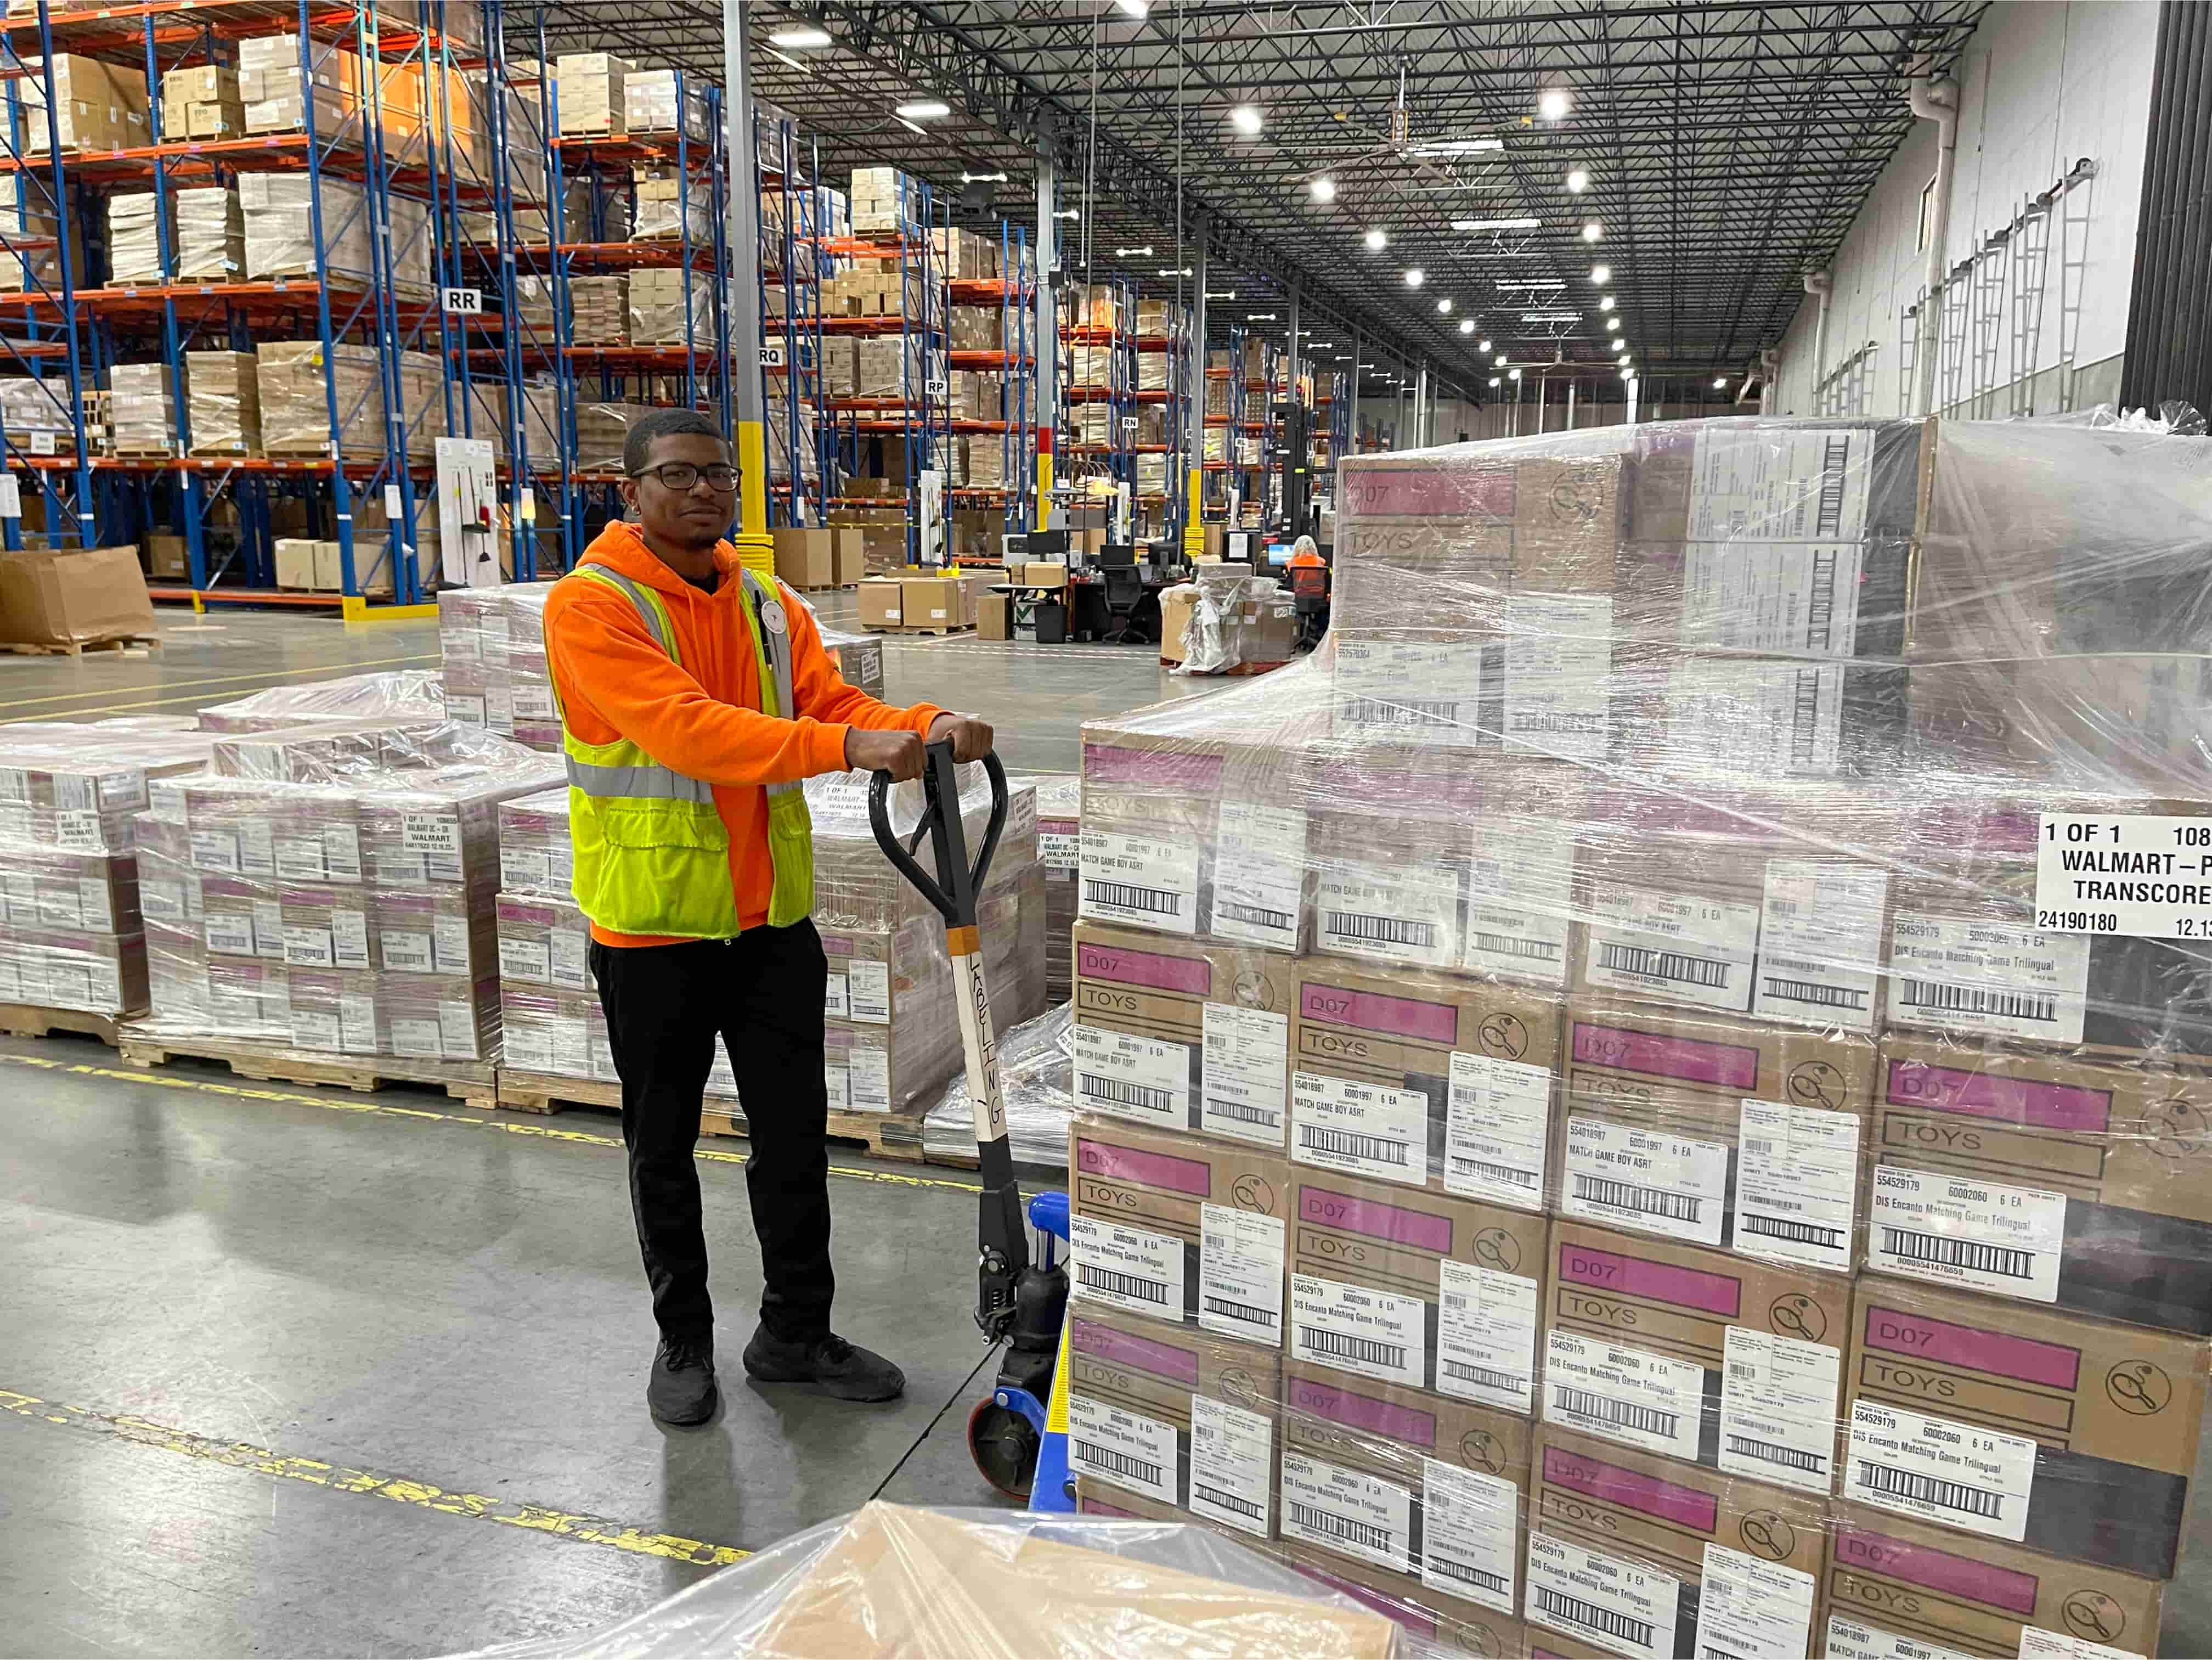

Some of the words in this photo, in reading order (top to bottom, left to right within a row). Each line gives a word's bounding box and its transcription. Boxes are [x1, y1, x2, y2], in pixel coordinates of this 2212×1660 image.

[450, 292, 475, 308] RR
[759, 350, 778, 363] RQ
[929, 382, 944, 392] RP
[1350, 532, 1413, 549] TOYS
[411, 834, 450, 842] WALMART
[2045, 823, 2055, 841] 1
[2067, 824, 2098, 842] OF
[2109, 825, 2119, 843] 1
[2173, 827, 2211, 846] 108
[1081, 853, 1099, 864] MATCH
[1101, 856, 1116, 867] GAME
[1116, 859, 1128, 869] BOY
[1701, 908, 1707, 918] 6
[1711, 910, 1721, 920] EA
[2039, 910, 2117, 932] 24190180
[2022, 935, 2028, 946] 6
[2034, 936, 2045, 947] EA
[1086, 955, 1119, 973] D07
[2013, 957, 2055, 974] Trilingual
[1086, 990, 1137, 1010] TOYS
[1311, 997, 1350, 1014] D07
[970, 955, 1001, 1124] LABELING
[1308, 1034, 1368, 1057] TOYS
[1585, 1037, 1630, 1058] D07
[1076, 1048, 1093, 1060] MATCH
[1122, 1057, 1135, 1068] ASRT
[1156, 1048, 1163, 1057] EA
[1295, 1079, 1325, 1093] 554018987
[1345, 1088, 1372, 1101] 60001997
[1381, 1094, 1385, 1103] 6
[1389, 1095, 1397, 1105] EA
[1581, 1078, 1651, 1102] TOYS
[1903, 1079, 1960, 1098] D07
[1294, 1097, 1314, 1109] MATCH
[1316, 1101, 1334, 1113] GAME
[1335, 1104, 1347, 1115] BOY
[1348, 1107, 1364, 1118] ASRT
[1571, 1125, 1607, 1141] 554018987
[1629, 1136, 1662, 1151] 60001997
[1672, 1145, 1678, 1155] 6
[1681, 1146, 1691, 1157] EA
[1898, 1123, 1982, 1150] TOYS
[1086, 1151, 1118, 1172] D07
[1569, 1144, 1593, 1158] MATCH
[1595, 1150, 1616, 1163] GAME
[1617, 1153, 1632, 1166] BOY
[1633, 1157, 1652, 1170] ASRT
[1086, 1185, 1137, 1206] TOYS
[1877, 1174, 1920, 1191] 554529179
[1948, 1186, 1988, 1202] 60002060
[2000, 1194, 2006, 1205] 6
[2011, 1196, 2022, 1208] EA
[1309, 1200, 1346, 1219] D07
[1875, 1195, 1889, 1208] DIS
[1892, 1198, 1923, 1213] Encanto
[1925, 1203, 1962, 1222] Matching
[1965, 1210, 1989, 1225] Game
[1991, 1215, 2030, 1234] Trilingual
[1101, 1246, 1123, 1261] Matching
[1125, 1252, 1139, 1263] Game
[1145, 1240, 1148, 1248] 6
[1151, 1241, 1157, 1250] EA
[1308, 1237, 1365, 1261] TOYS
[1572, 1259, 1616, 1280] D07
[1897, 1257, 1963, 1276] 00005541476659
[1294, 1282, 1323, 1296] 554529179
[1343, 1292, 1370, 1306] 60002060
[1379, 1300, 1383, 1309] 6
[1387, 1302, 1394, 1311] EA
[1294, 1299, 1303, 1310] DIS
[1305, 1302, 1327, 1315] Encanto
[1329, 1307, 1354, 1322] Matching
[1356, 1313, 1372, 1325] Game
[1374, 1316, 1401, 1332] Trilingual
[1569, 1297, 1637, 1324] TOYS
[1880, 1323, 1934, 1346] D07
[1550, 1338, 1585, 1355] 554529179
[1607, 1352, 1640, 1369] 60002060
[1650, 1362, 1655, 1372] 6
[1659, 1364, 1668, 1375] EA
[1082, 1365, 1129, 1389] TOYS
[1549, 1357, 1560, 1368] DIS
[1562, 1360, 1588, 1375] Encanto
[1589, 1366, 1620, 1385] Matching
[1622, 1375, 1641, 1388] Game
[1643, 1380, 1675, 1399] Trilingual
[1875, 1365, 1955, 1396] TOYS
[1299, 1391, 1335, 1410] D07
[1098, 1425, 1119, 1440] Matching
[1299, 1427, 1353, 1451] TOYS
[1854, 1410, 1896, 1429] 554529179
[1923, 1426, 1961, 1444] 60002060
[1972, 1438, 1978, 1448] 6
[1983, 1440, 1994, 1451] EA
[1853, 1430, 1866, 1442] DIS
[1869, 1434, 1899, 1450] Encanto
[1900, 1442, 1936, 1461] Matching
[1938, 1450, 1961, 1465] Game
[1963, 1456, 2001, 1477] Trilingual
[1331, 1473, 1358, 1489] 60002060
[1374, 1486, 1381, 1496] EA
[1295, 1479, 1316, 1493] Encanto
[1317, 1486, 1342, 1503] Matching
[1344, 1494, 1359, 1507] Game
[1361, 1499, 1387, 1517] Trilingual
[1872, 1489, 1936, 1512] 00005541476659
[1551, 1498, 1617, 1530] TOYS
[1531, 1540, 1565, 1560] 554529179
[1587, 1559, 1618, 1578] 60002060
[1627, 1573, 1632, 1582] 6
[1636, 1575, 1645, 1586] EA
[1848, 1541, 1901, 1564] D07
[1530, 1558, 1541, 1570] DIS
[1543, 1562, 1567, 1579] Encanto
[1569, 1571, 1598, 1591] Matching
[1600, 1582, 1618, 1597] Game
[1620, 1589, 1651, 1610] Trilingual
[1846, 1577, 1920, 1612] TOYS
[1830, 1642, 1855, 1657] MATCH
[1831, 1624, 1870, 1644] 554018987
[1895, 1644, 1931, 1659] 60001997
